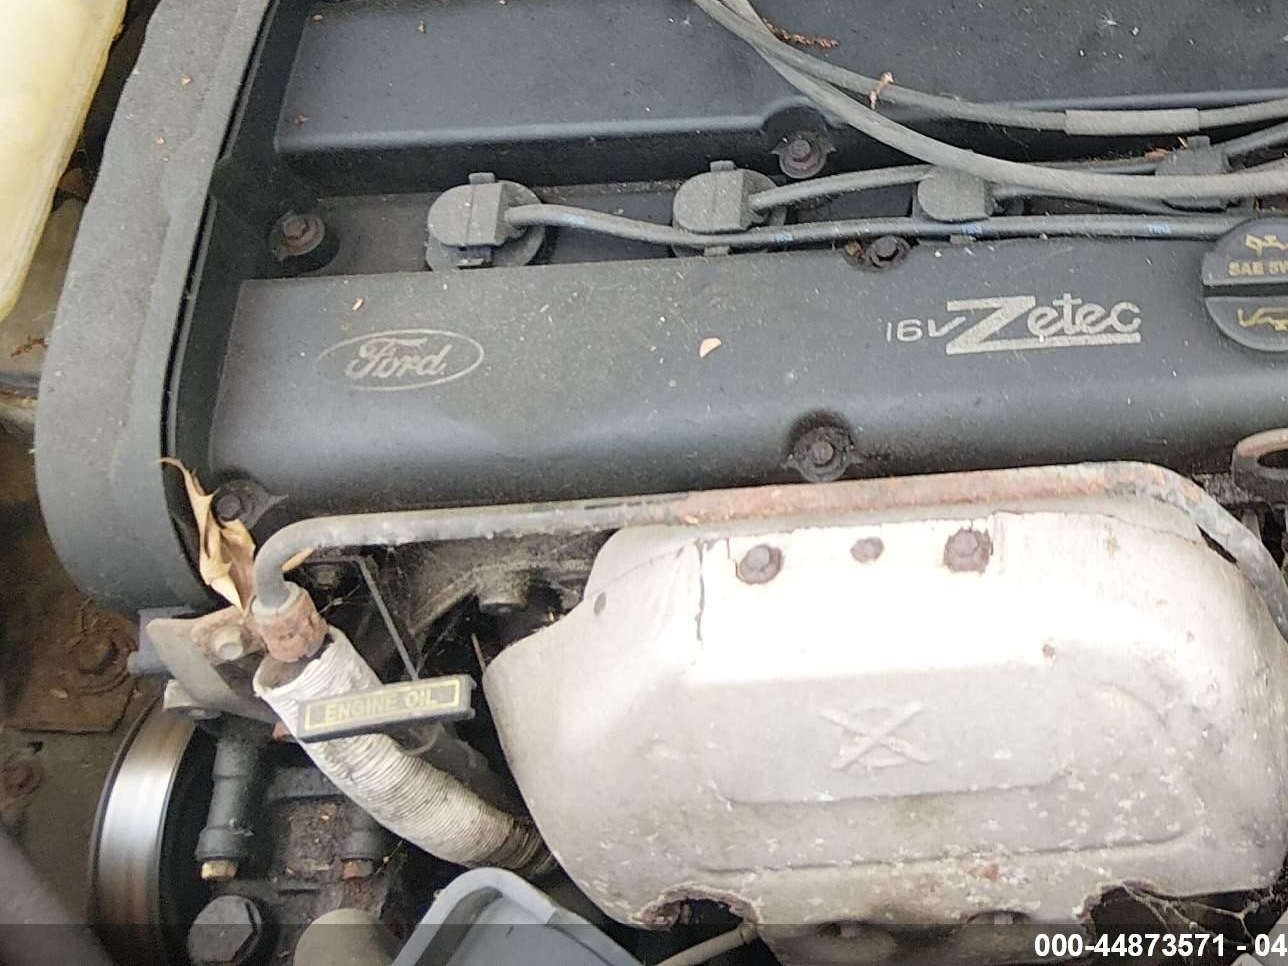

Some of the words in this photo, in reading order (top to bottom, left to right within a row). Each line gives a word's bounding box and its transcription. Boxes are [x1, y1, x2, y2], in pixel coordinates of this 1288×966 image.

[1228, 261, 1265, 276] SAE
[885, 316, 967, 343] 16V
[946, 292, 1142, 355] Zetec
[345, 337, 453, 379] Ford
[323, 696, 398, 723] ENGINE
[404, 688, 439, 710] OIL
